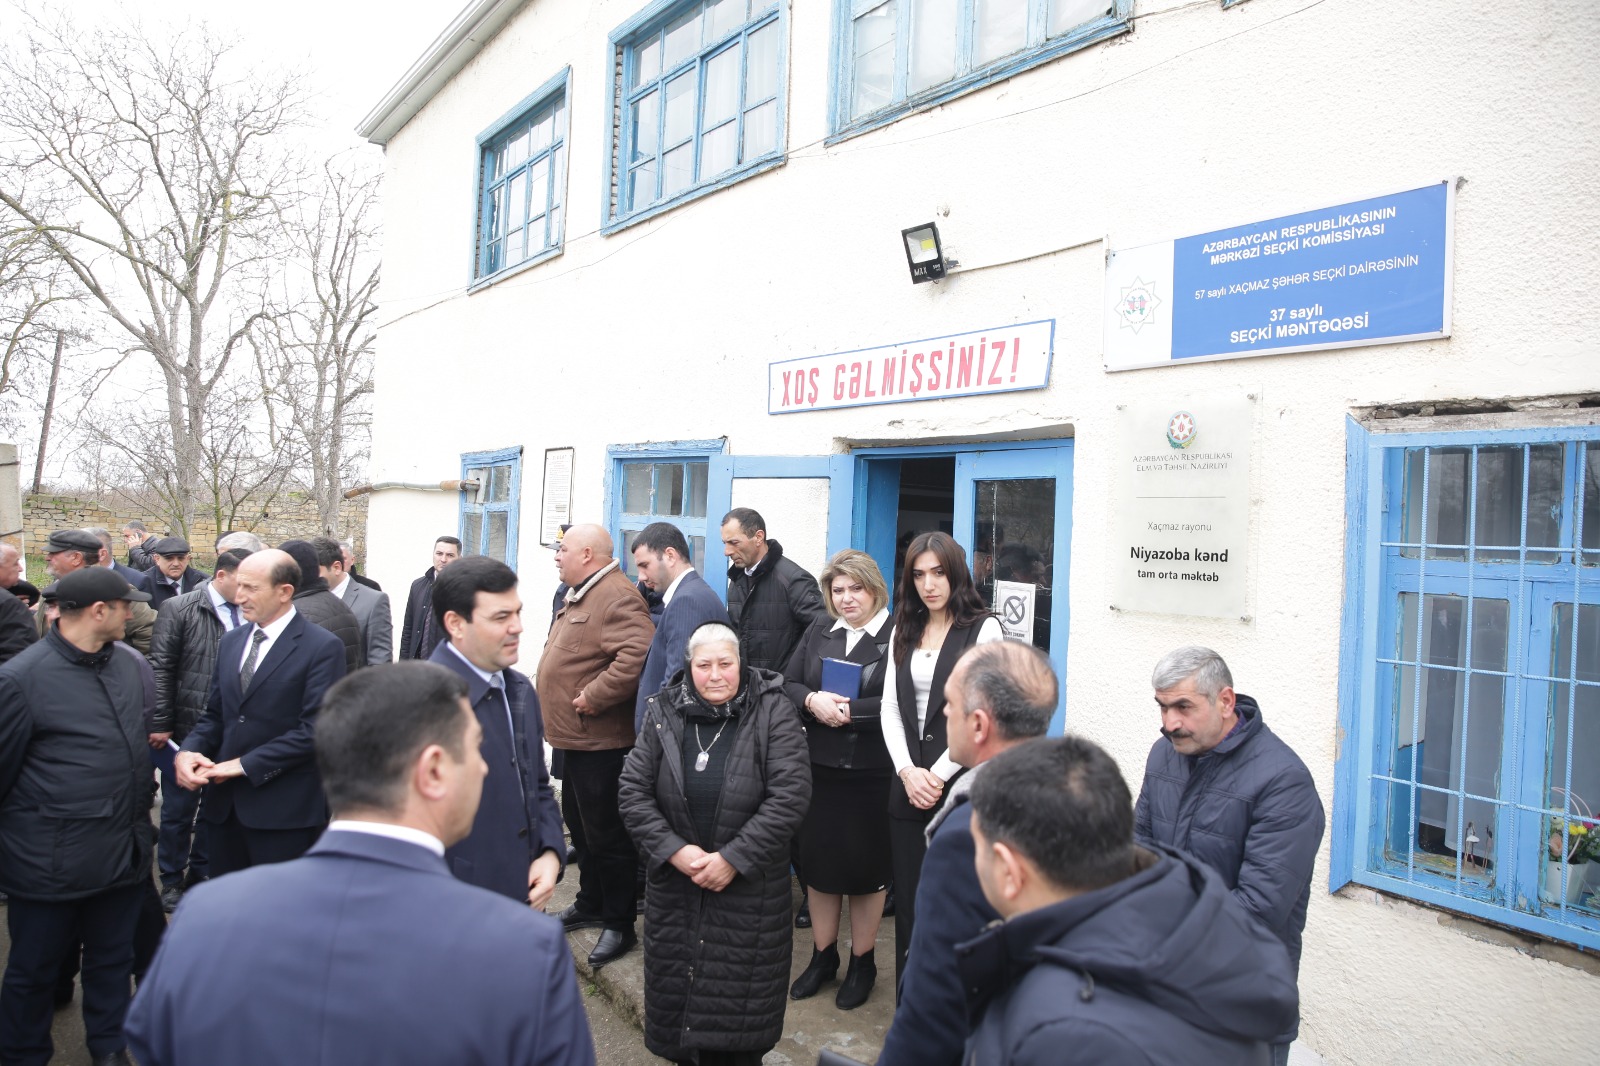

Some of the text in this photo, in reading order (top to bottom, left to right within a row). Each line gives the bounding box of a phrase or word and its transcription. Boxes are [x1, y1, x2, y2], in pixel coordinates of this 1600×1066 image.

[1202, 206, 1396, 254] AZƏRBAYCAN RESPUBLİKASININ
[1210, 223, 1385, 266] MƏRKƏZİ SEÇKİ KOMİSSİYASI
[1195, 254, 1419, 300] 57 saylı XAÇMAZ ŞƏHƏR SEÇKİ DAİRƏSİNİN
[1230, 311, 1369, 344] SEÇKİ MƏNTƏQƏSİ
[1270, 303, 1323, 322] 37 saylı
[782, 337, 1020, 407] XOŞ GƏLMİŞSİNİZ!
[1147, 521, 1212, 534] Xaçmaz rayonu
[1130, 546, 1229, 563] Niyazoba kənd
[1137, 569, 1219, 582] tam orta məktəb
